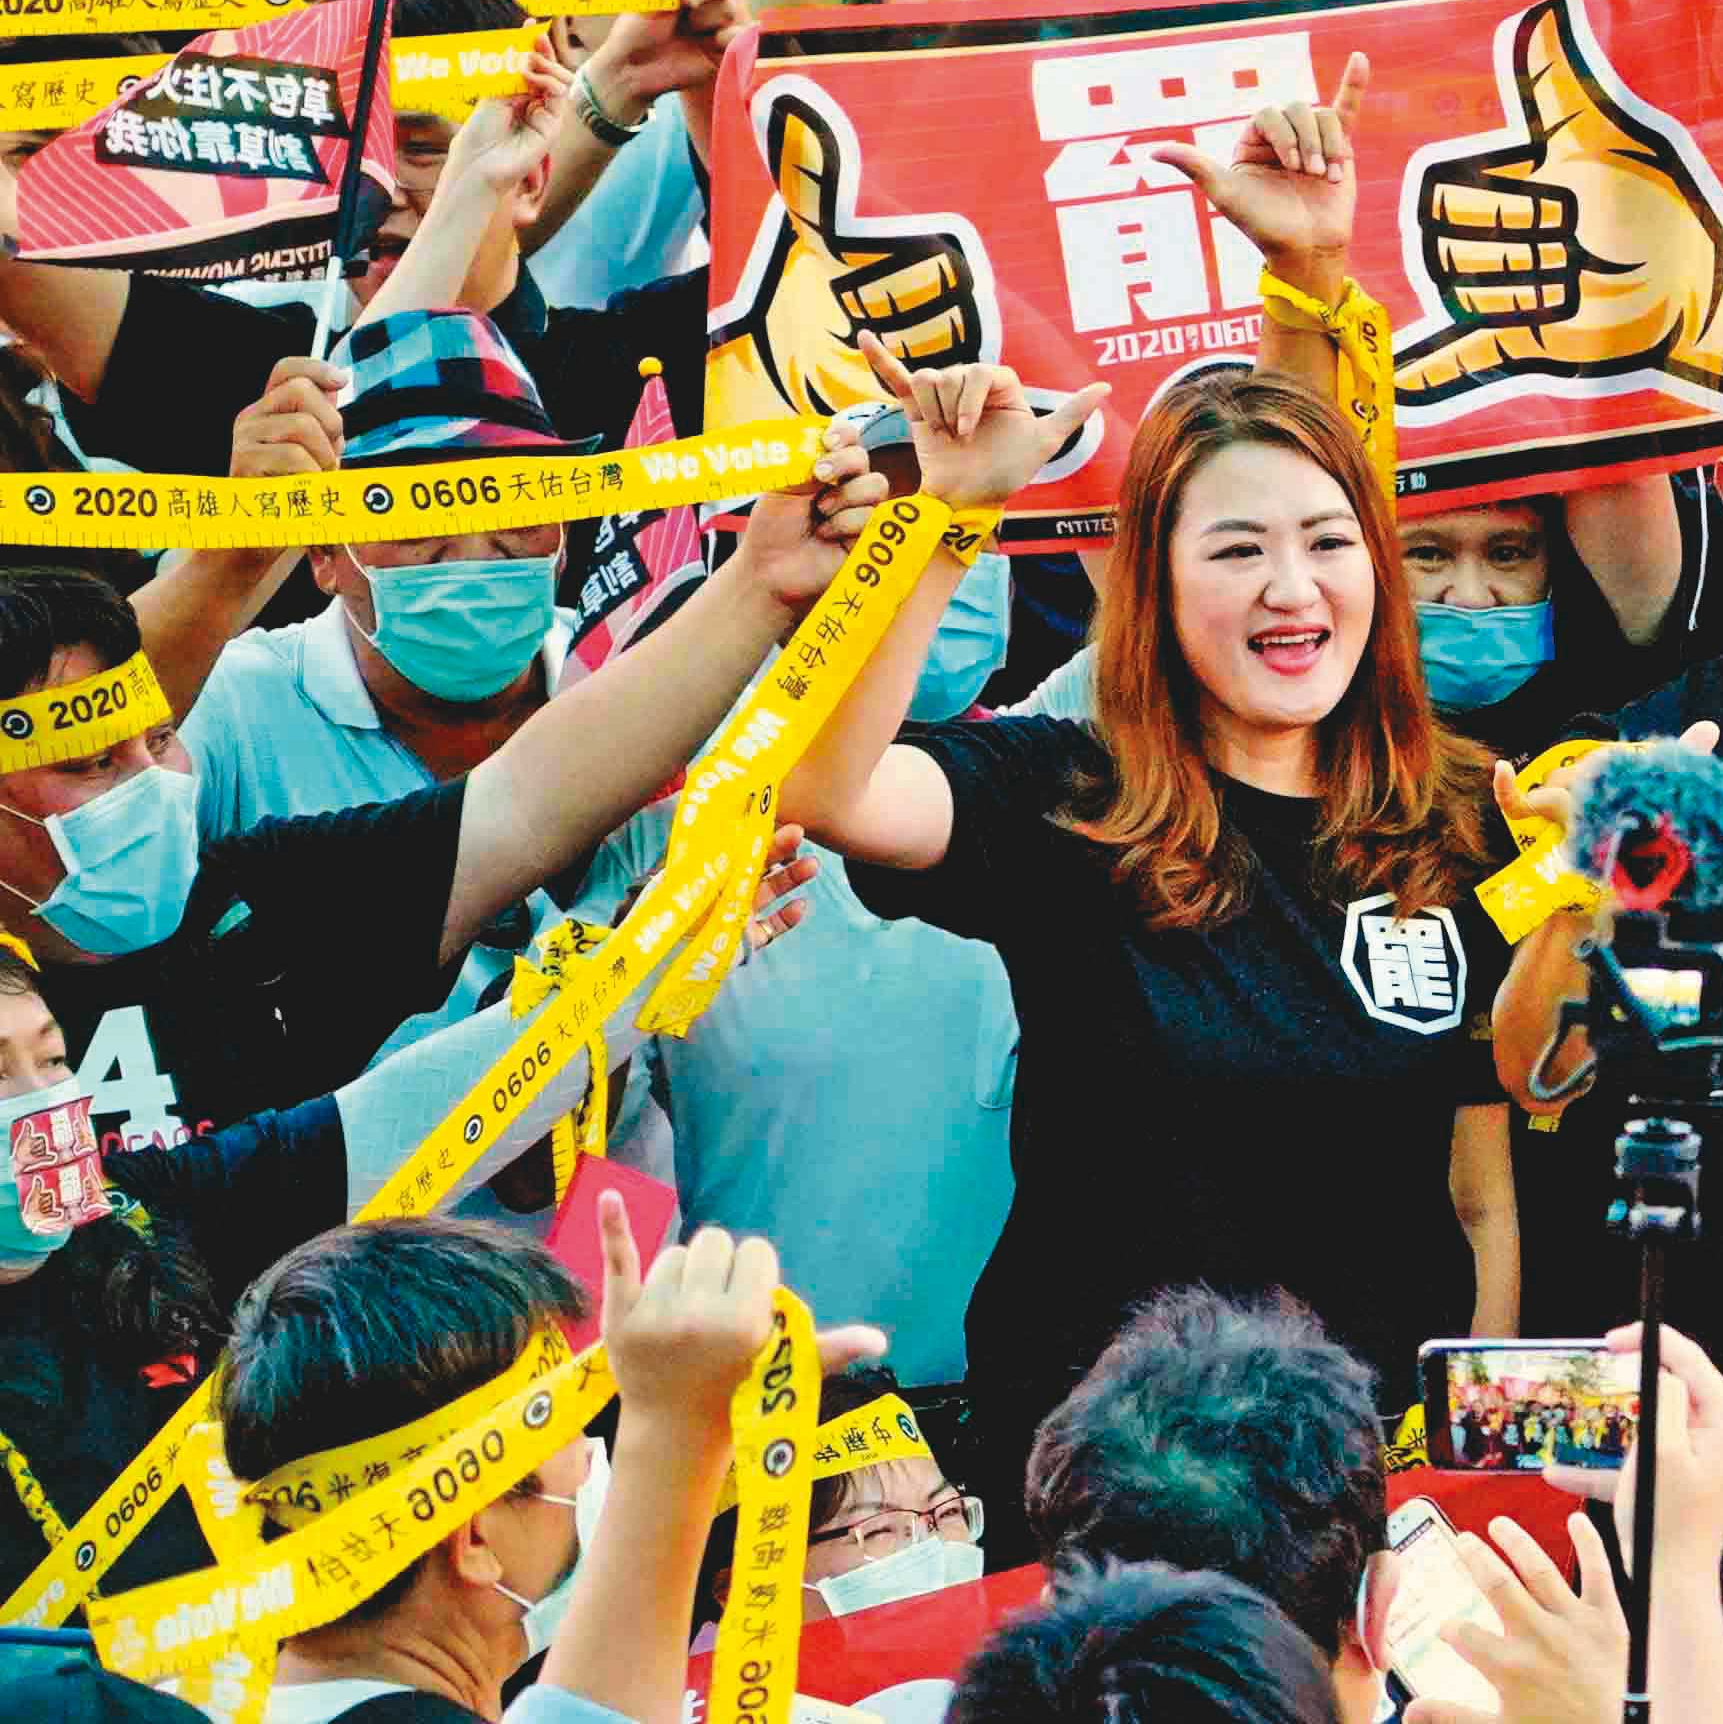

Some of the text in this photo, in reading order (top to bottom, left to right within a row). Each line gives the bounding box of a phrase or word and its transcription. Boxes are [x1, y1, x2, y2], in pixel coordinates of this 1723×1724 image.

[396, 49, 448, 81] We
[1033, 31, 1319, 335] 罷
[74, 441, 791, 520] 2020 高雄人寫歷史 0606 天佑台灣 We Vote
[855, 501, 921, 590] 0606
[48, 681, 129, 731] 2020
[490, 1042, 553, 1117] 0606
[635, 911, 676, 953] We
[75, 1004, 183, 1151] 4
[104, 1464, 165, 1538] 0606
